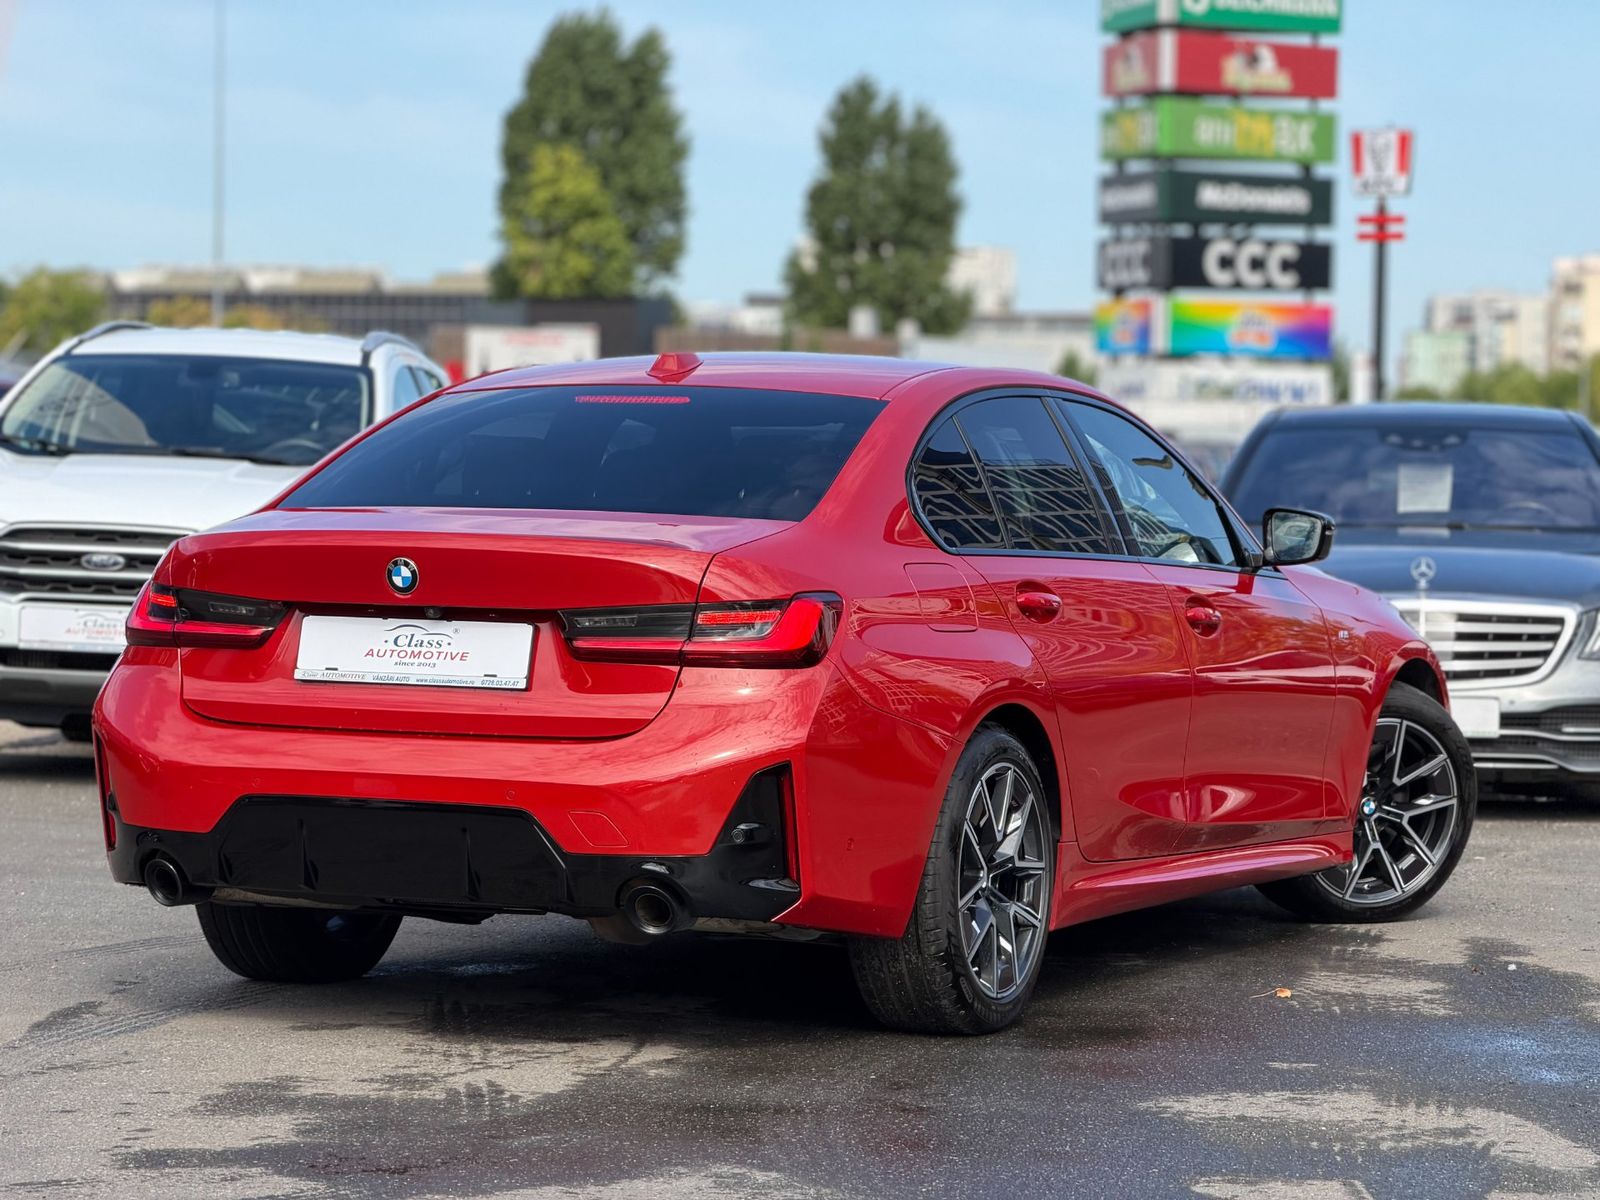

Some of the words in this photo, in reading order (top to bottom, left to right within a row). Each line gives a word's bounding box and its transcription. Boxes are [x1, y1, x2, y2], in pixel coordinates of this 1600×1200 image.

[1202, 240, 1301, 289] CCC
[393, 633, 444, 649] Class
[364, 648, 470, 662] AUTOMOTIVE
[320, 671, 367, 680] AUTOMOTIVE
